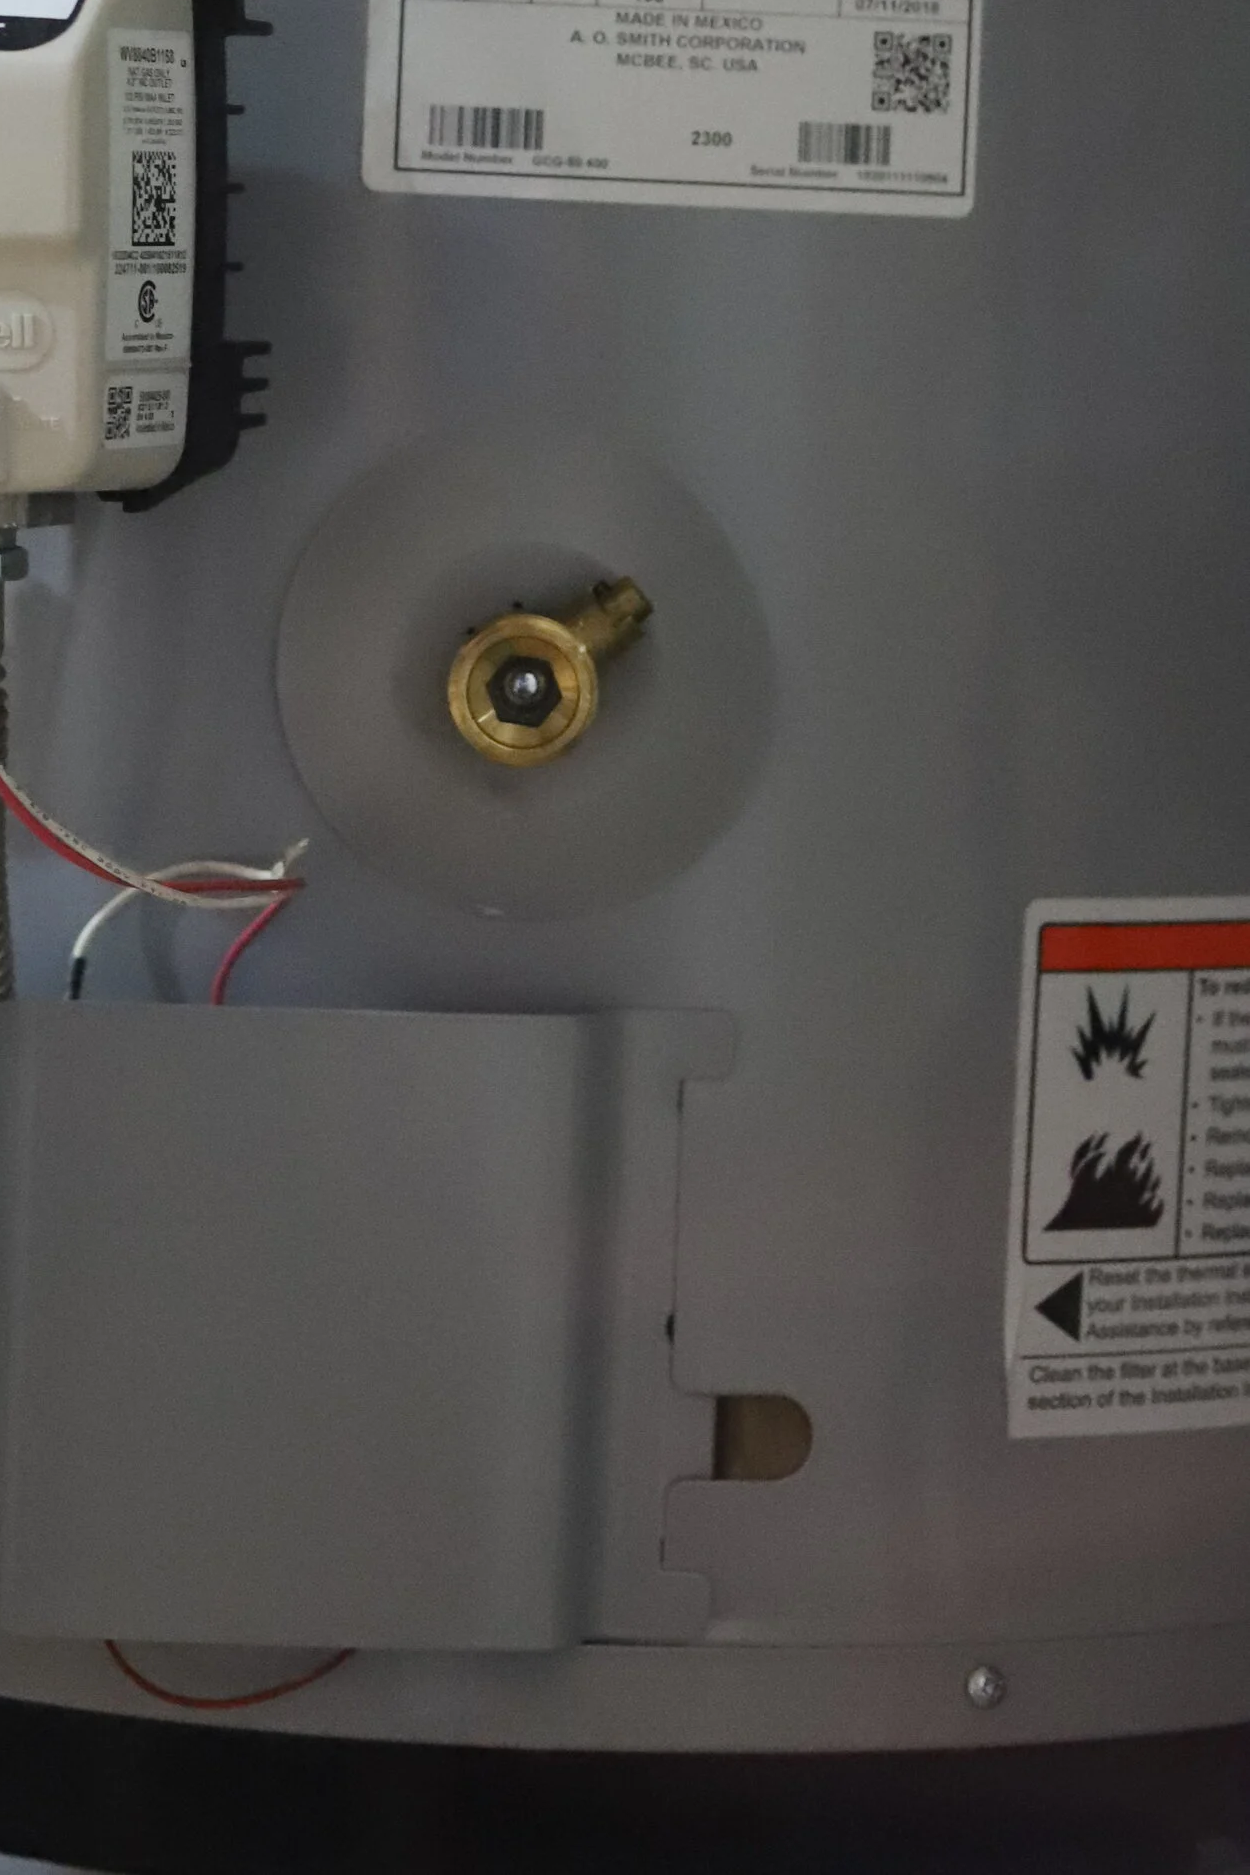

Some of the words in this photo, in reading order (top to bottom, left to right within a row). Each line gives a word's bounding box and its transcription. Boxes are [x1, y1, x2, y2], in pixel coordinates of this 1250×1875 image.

[616, 12, 667, 25] MADE
[672, 13, 689, 27] IN
[694, 16, 763, 31] MEXICO
[616, 32, 670, 47] SMITH
[676, 35, 806, 53] CORPORATION
[722, 58, 758, 71] USA
[691, 131, 732, 147] 2300
[1028, 1363, 1082, 1386] Clean
[1087, 1363, 1115, 1383] the
[1120, 1361, 1157, 1382] filter
[1162, 1358, 1180, 1377] at
[1184, 1357, 1211, 1377] the
